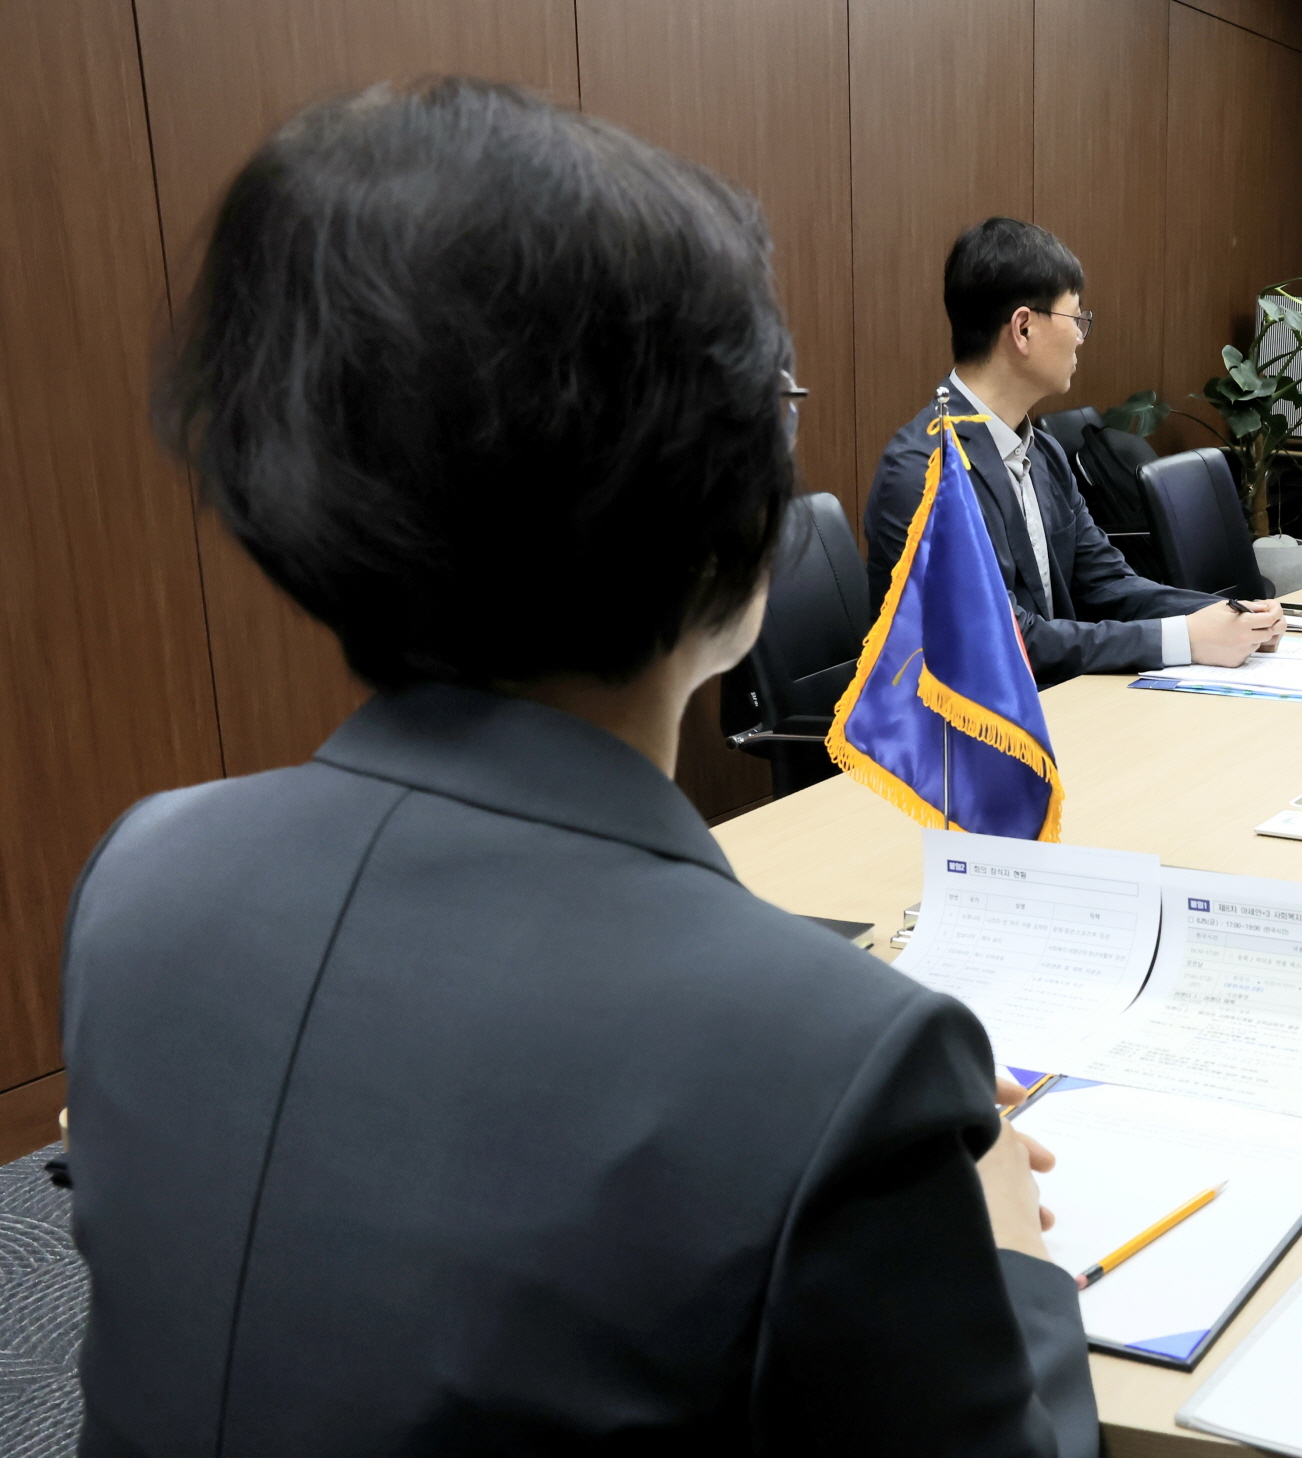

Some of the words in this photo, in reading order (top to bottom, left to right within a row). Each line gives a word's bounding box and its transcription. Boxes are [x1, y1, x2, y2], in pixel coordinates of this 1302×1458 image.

[973, 865, 987, 874] 회의
[990, 867, 1010, 878] 참석자
[1013, 870, 1027, 879] 현황
[1218, 904, 1237, 914] 제8차
[1241, 907, 1270, 918] 아세안+3
